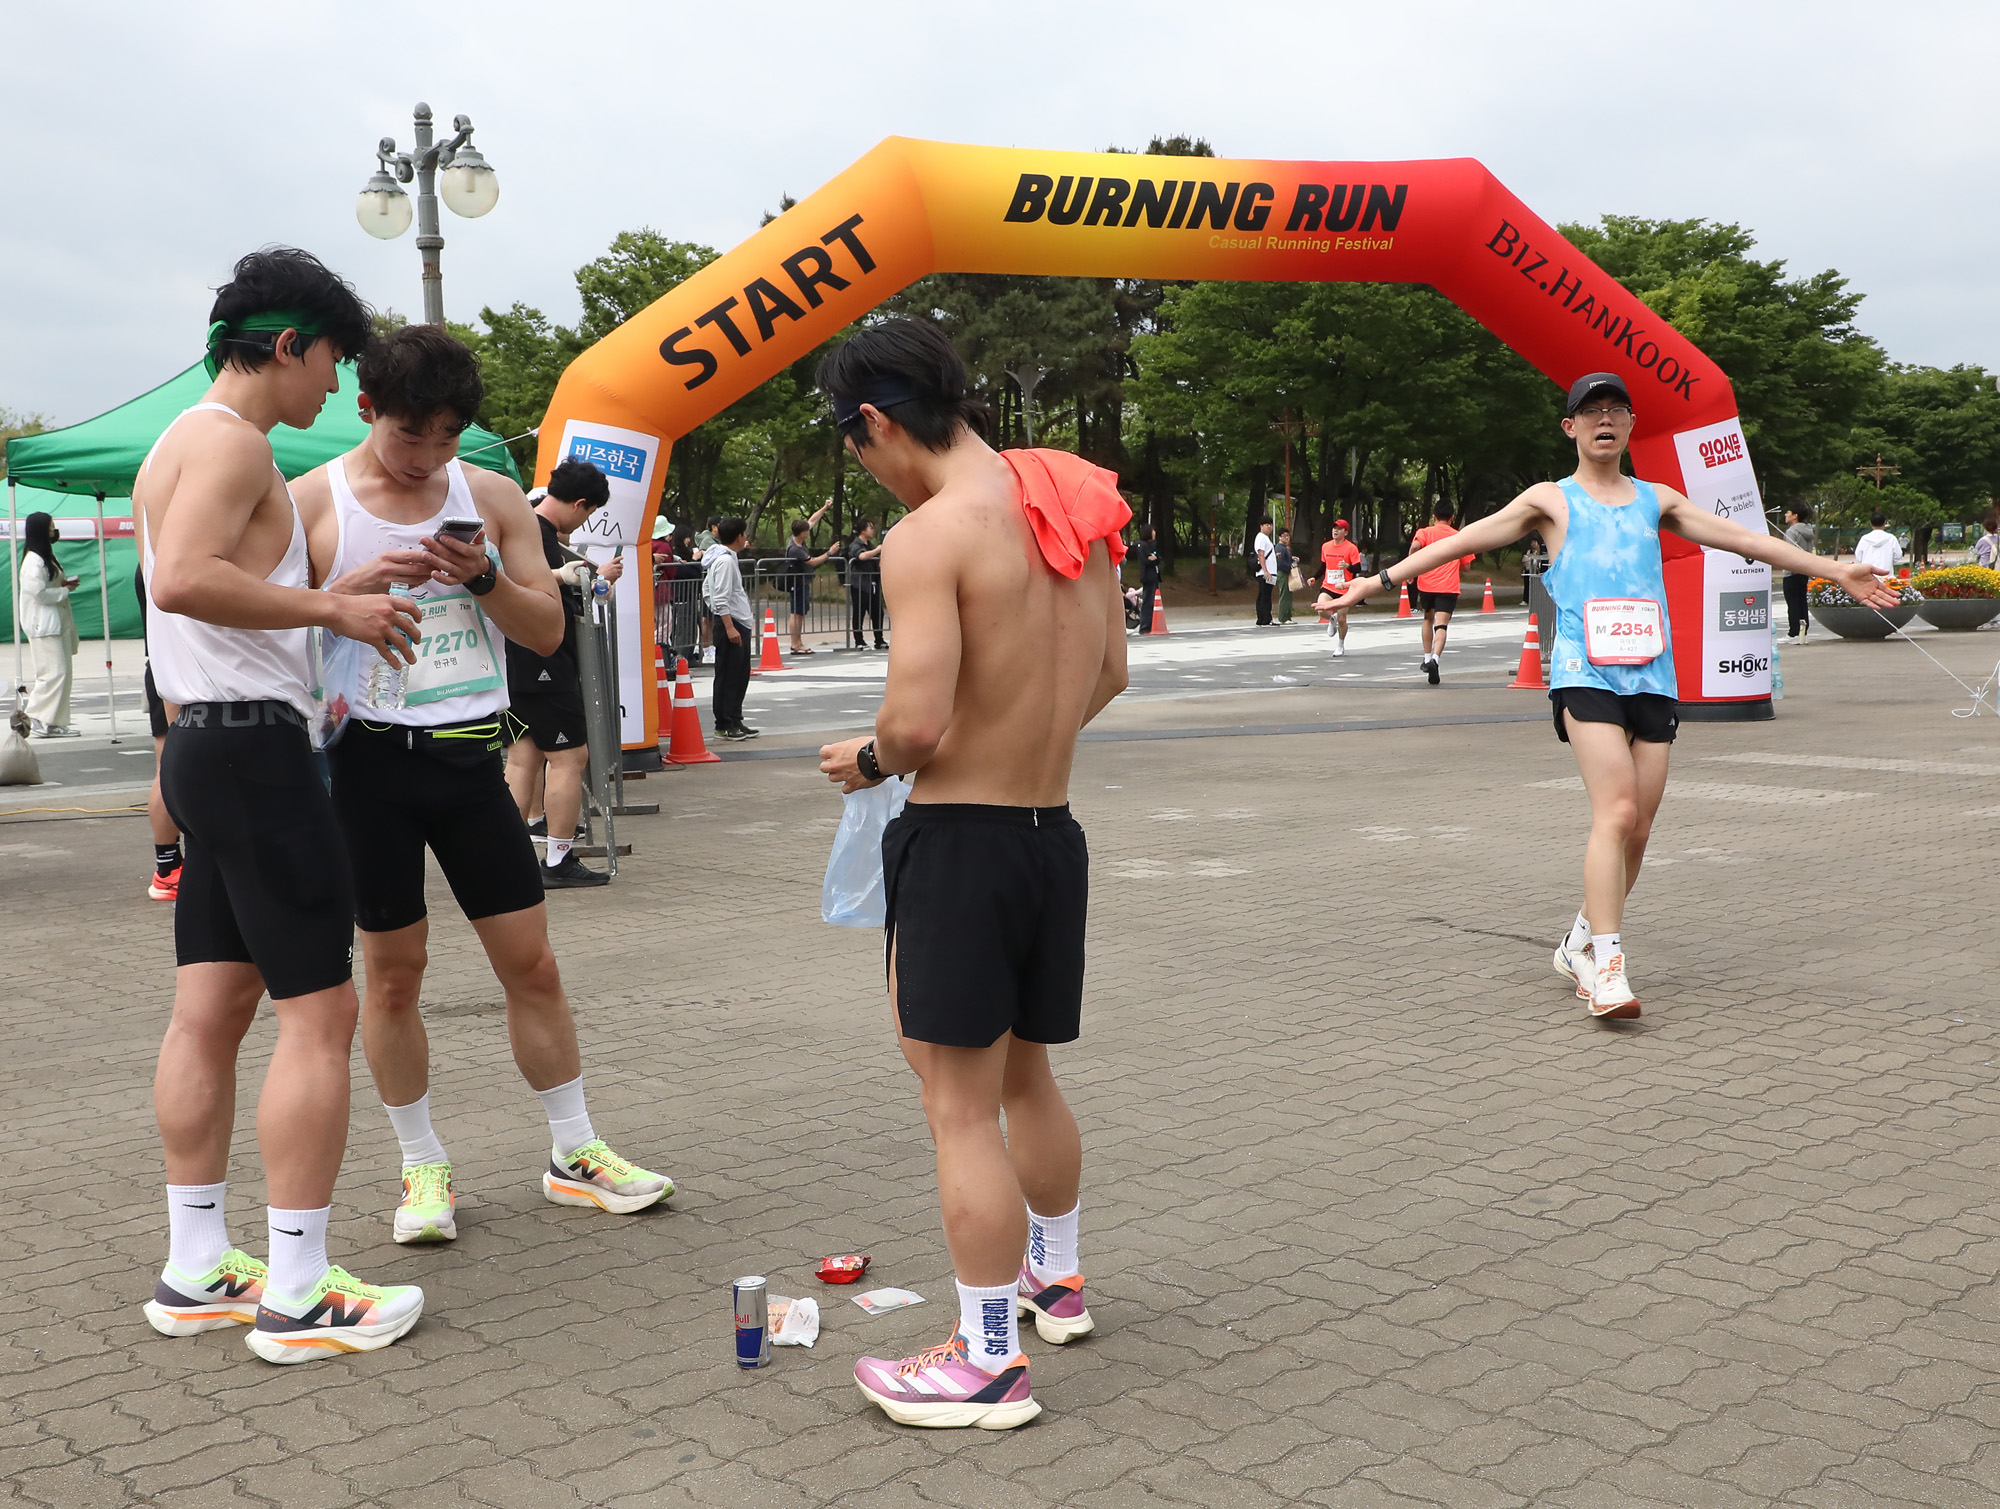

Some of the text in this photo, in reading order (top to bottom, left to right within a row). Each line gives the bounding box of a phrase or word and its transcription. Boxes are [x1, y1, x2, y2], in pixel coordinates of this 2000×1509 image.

[1003, 174, 1408, 232] BURNING RUN
[1208, 235, 1393, 253] Casual Running Festival
[659, 213, 877, 391] START
[575, 443, 640, 476] 비즈한국
[1699, 433, 1743, 469] 일요신문
[428, 605, 447, 616] RUN
[1724, 608, 1767, 627] 동원샘물
[1596, 622, 1654, 636] M 2354
[420, 629, 478, 657] 7270
[1718, 657, 1768, 674] SHOKZ
